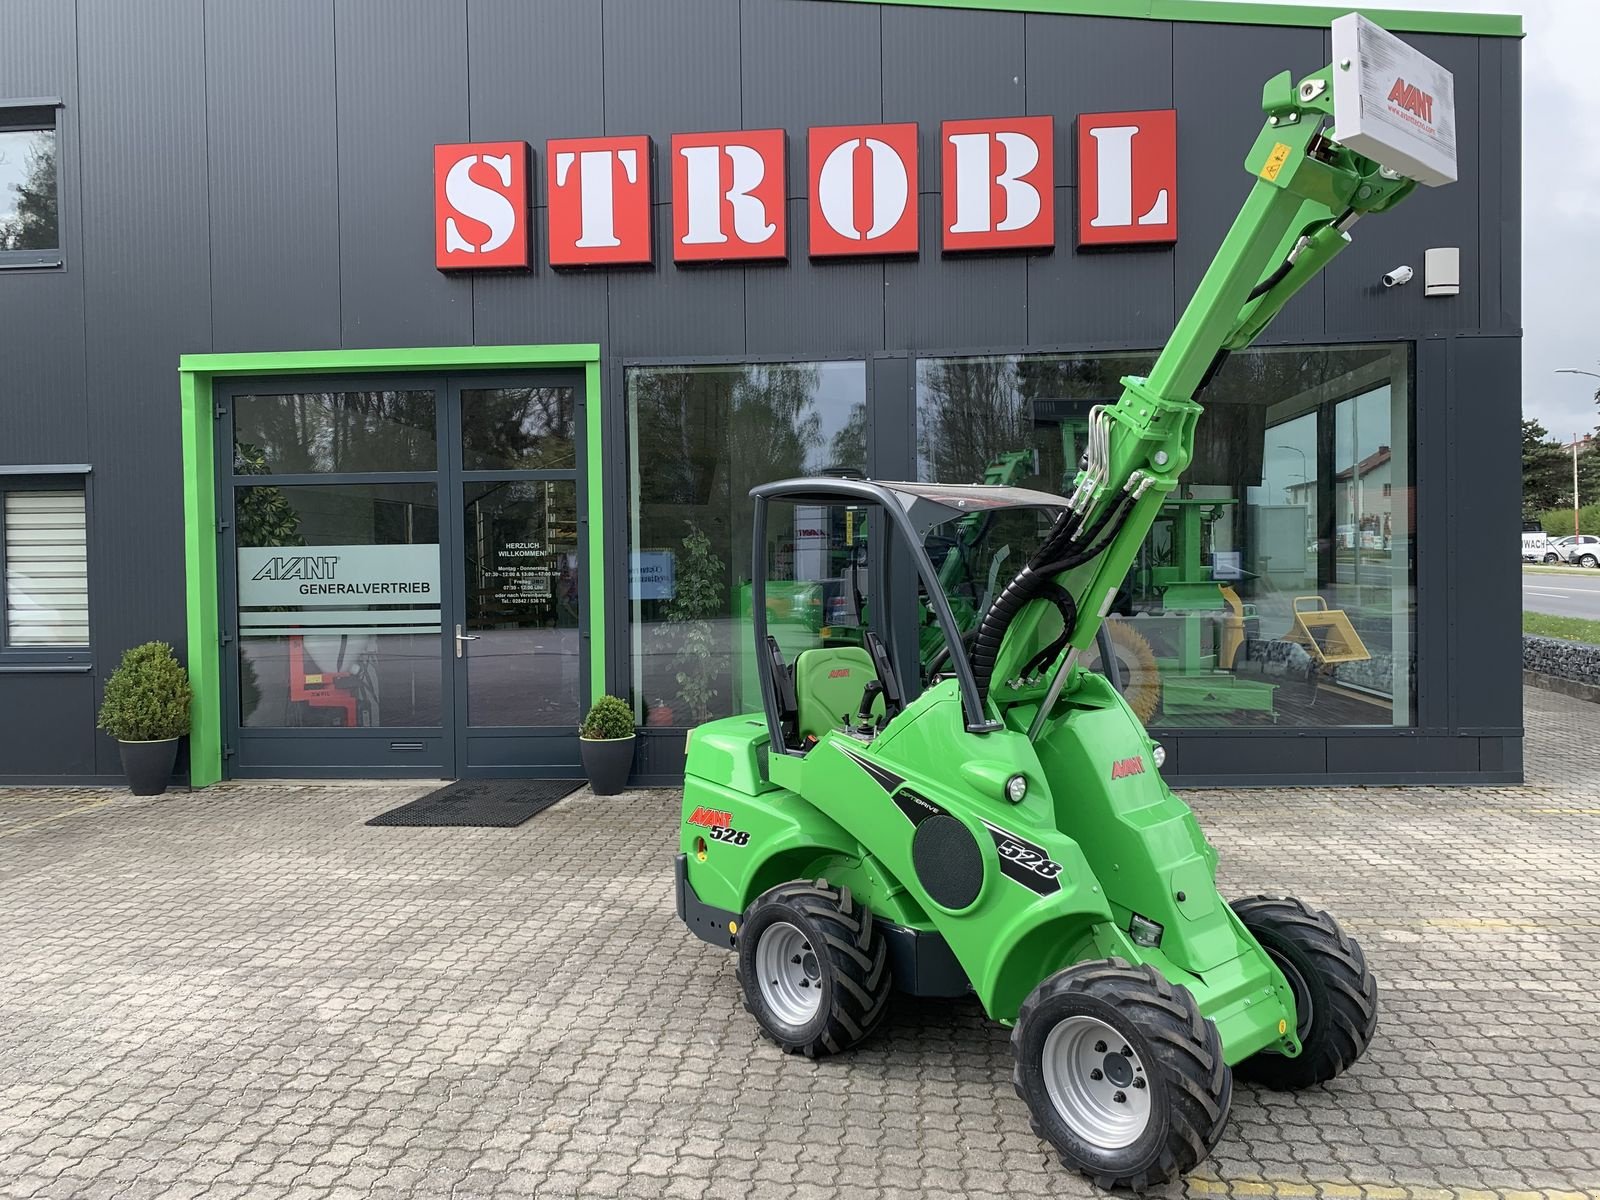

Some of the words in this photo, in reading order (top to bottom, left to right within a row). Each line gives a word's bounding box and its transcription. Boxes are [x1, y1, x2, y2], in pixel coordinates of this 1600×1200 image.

[1387, 77, 1433, 124] AVANT
[445, 126, 1168, 254] STROBL
[1522, 539, 1545, 549] WACH
[251, 556, 338, 581] AVANT
[299, 582, 431, 595] GENERALVERTRIEB
[1111, 755, 1145, 780] AVANT
[686, 805, 733, 829] AVANT
[709, 825, 751, 847] 528
[997, 839, 1064, 879] 528
